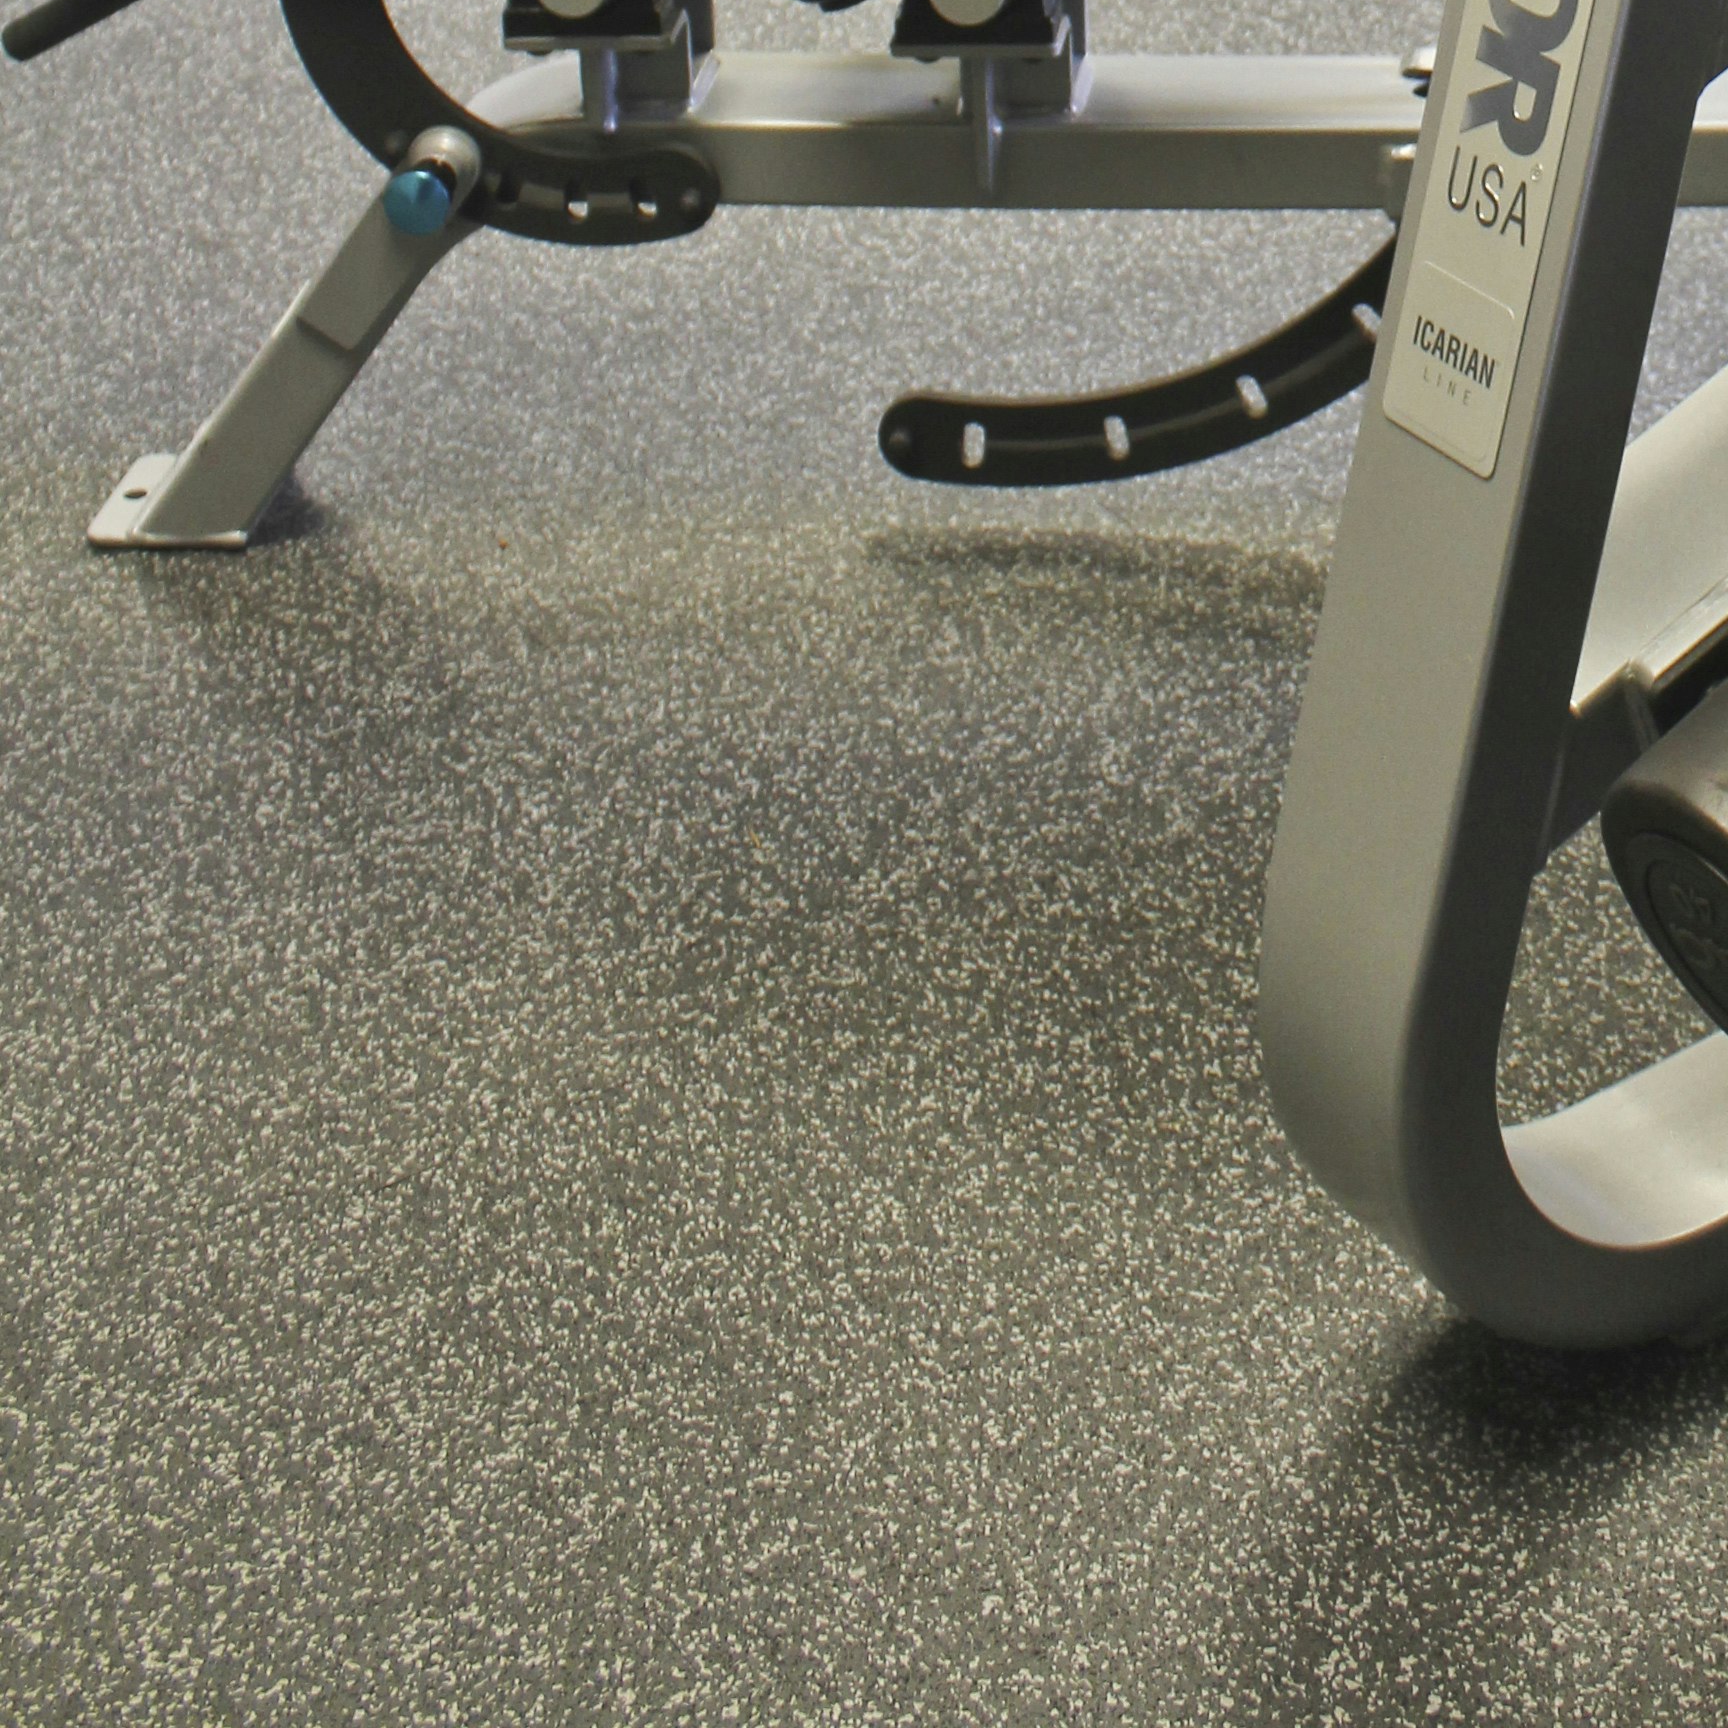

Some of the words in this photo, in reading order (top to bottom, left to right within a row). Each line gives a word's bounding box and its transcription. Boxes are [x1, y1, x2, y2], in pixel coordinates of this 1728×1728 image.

[1448, 146, 1528, 247] USA
[1413, 315, 1496, 389] ICARIAN
[1423, 365, 1473, 407] LINE
